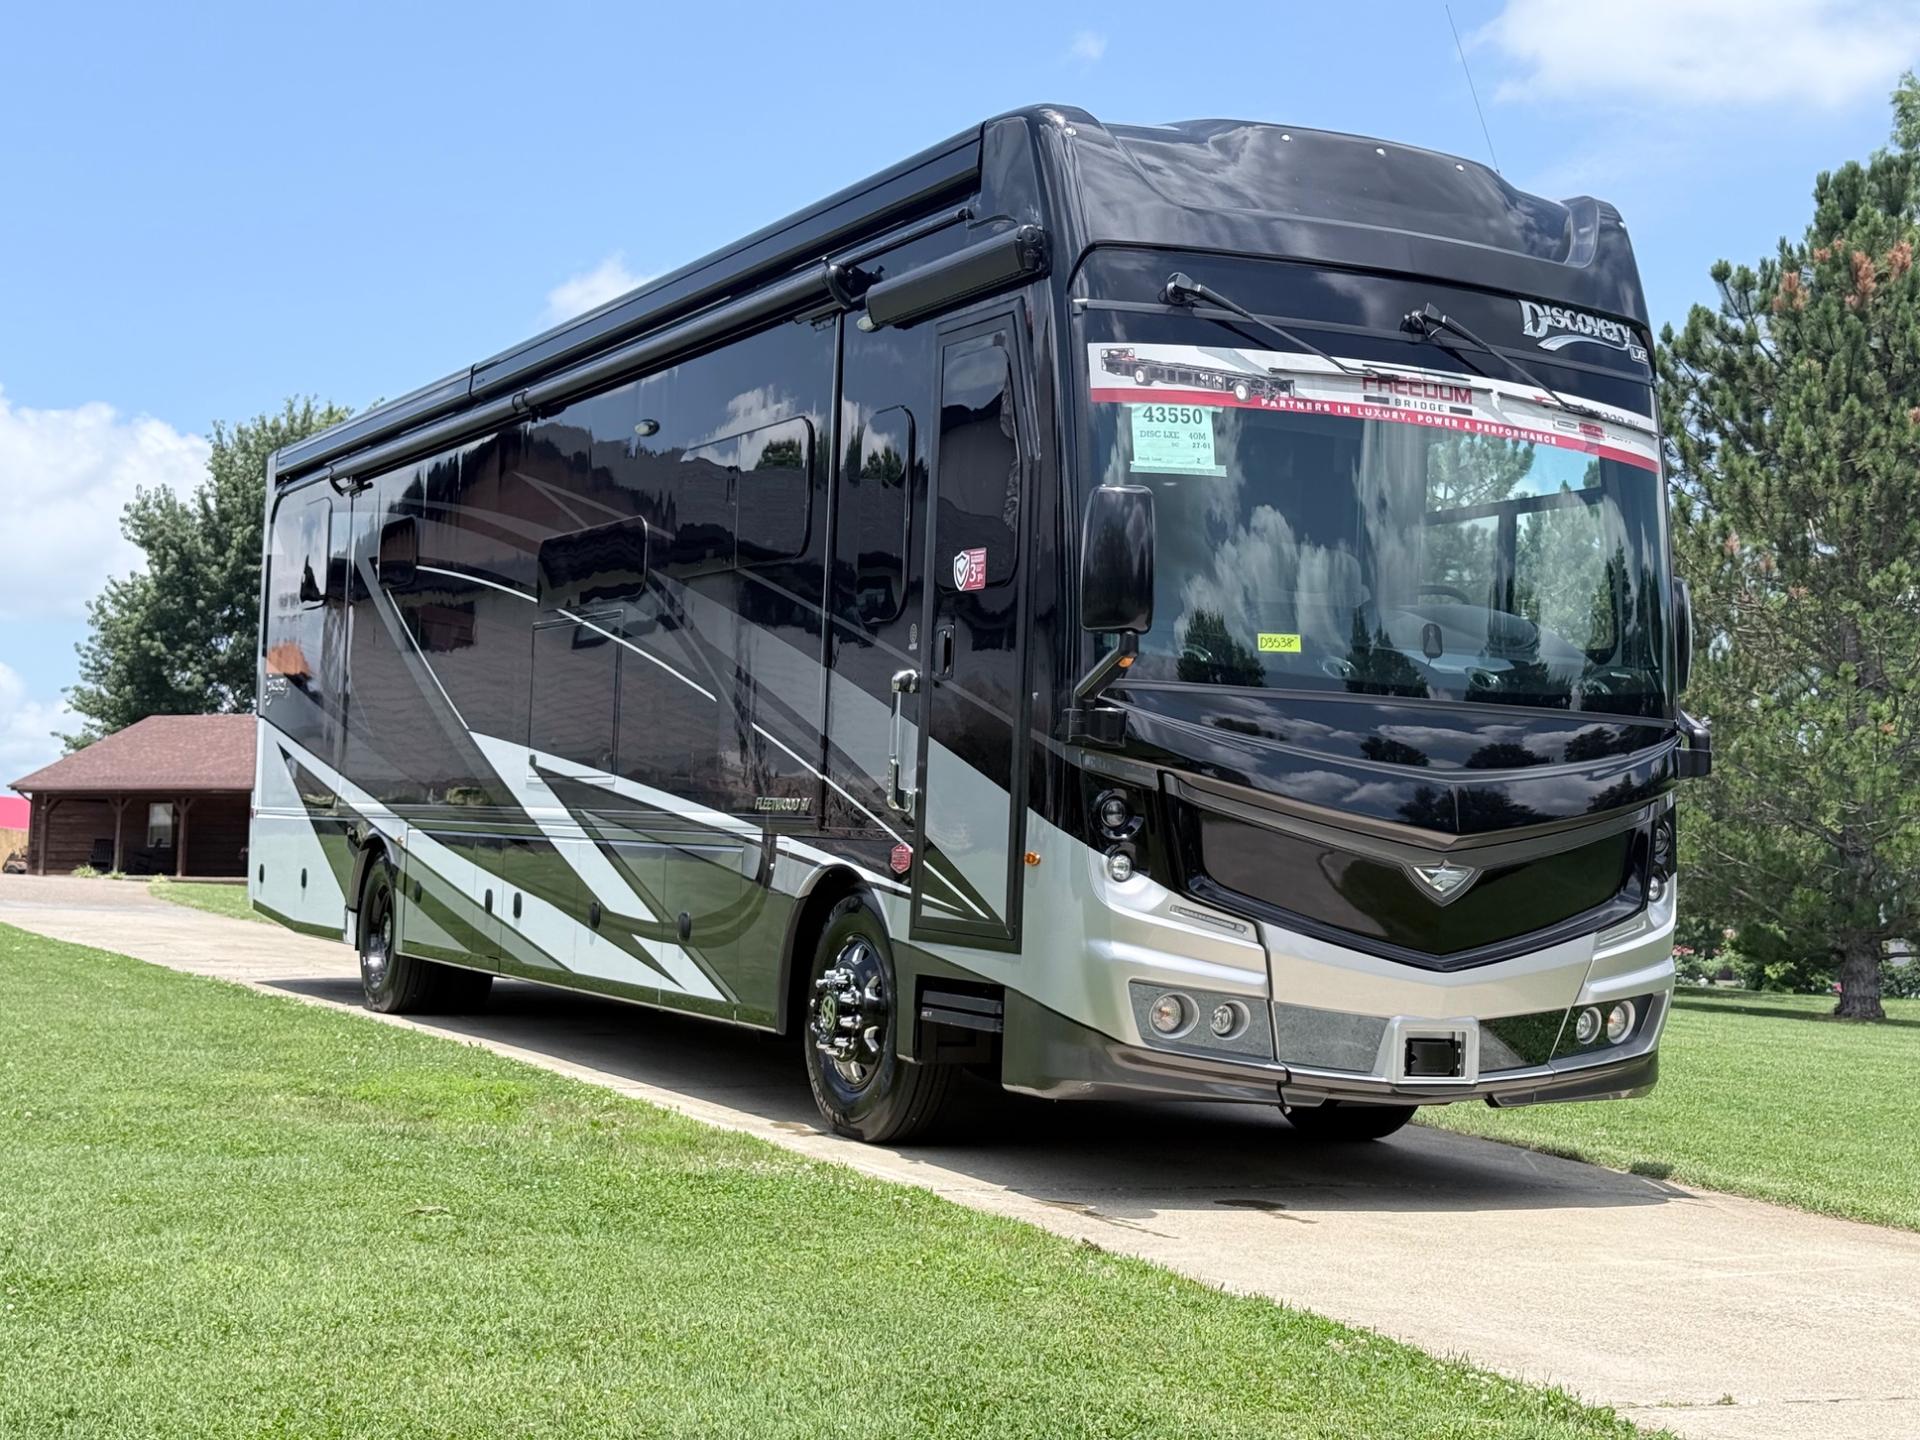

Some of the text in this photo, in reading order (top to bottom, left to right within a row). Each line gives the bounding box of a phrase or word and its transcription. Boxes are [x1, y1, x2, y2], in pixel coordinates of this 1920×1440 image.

[1394, 398, 1445, 413] BRIDGE
[1142, 406, 1203, 424] 43550
[1261, 398, 1330, 413] PARTNERS
[1337, 404, 1351, 415] IN
[1357, 407, 1411, 423] LUXURY,
[1417, 414, 1458, 428] POWER
[1464, 422, 1471, 430] &
[1476, 423, 1557, 445] PERFORMANCE
[1139, 430, 1162, 438] DISC
[754, 796, 800, 811] FLEETWOOD
